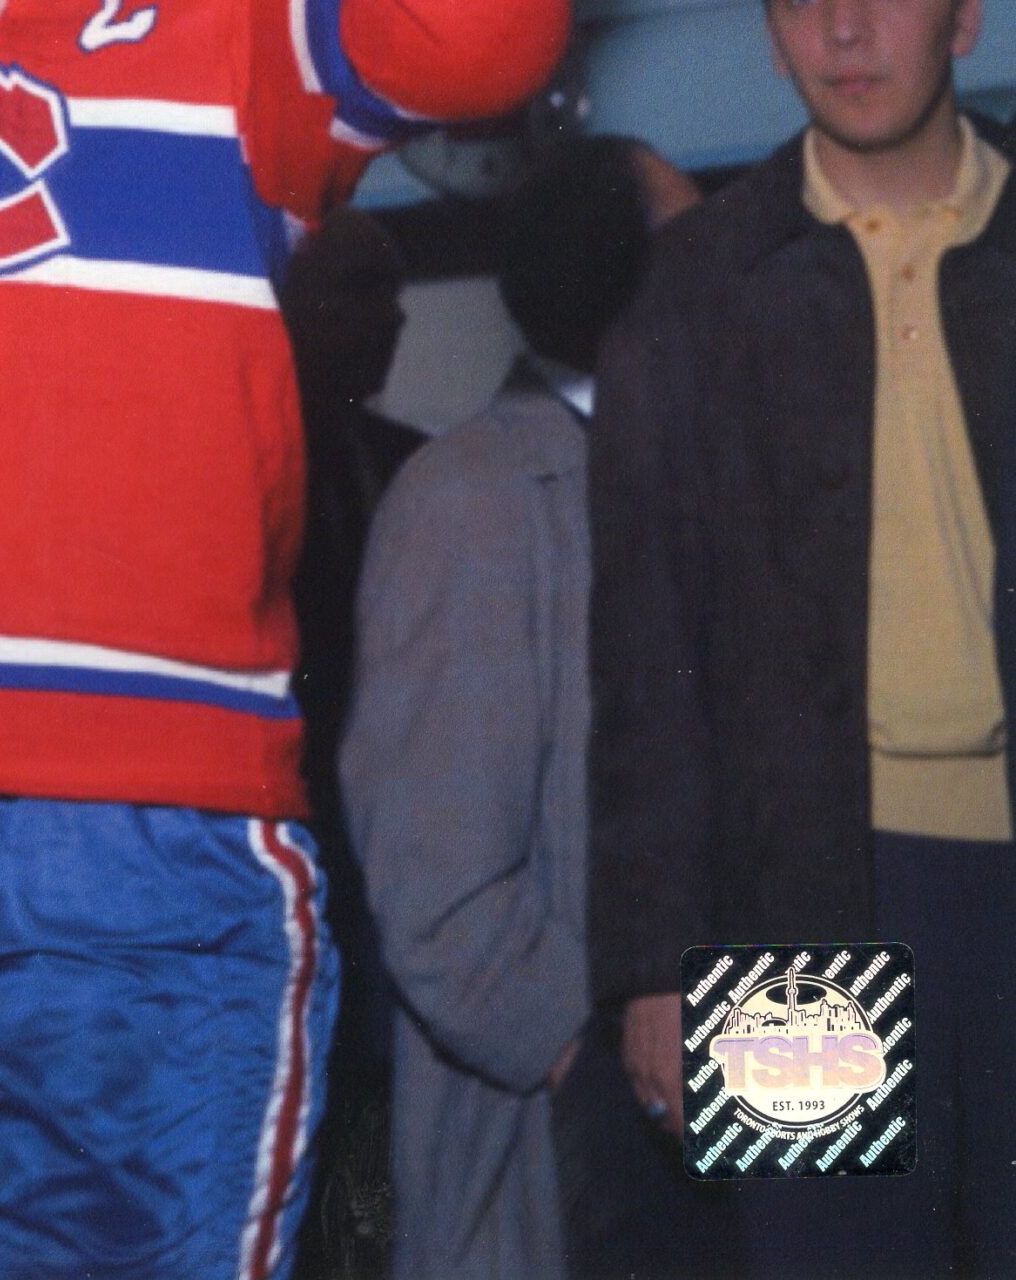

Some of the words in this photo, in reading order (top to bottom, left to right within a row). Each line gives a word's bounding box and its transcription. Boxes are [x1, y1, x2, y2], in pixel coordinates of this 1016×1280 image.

[687, 955, 733, 1007] Authentic
[728, 952, 775, 1003] Authentic
[822, 950, 851, 979] entic
[849, 951, 890, 997] uthentic
[684, 1001, 731, 1053] Authentic
[687, 1059, 720, 1093] Authe
[713, 1033, 881, 1090] TSHS
[866, 1059, 913, 1111] Authentic
[689, 1086, 731, 1135] Authent
[733, 1107, 767, 1133] TORONTO
[839, 1104, 865, 1128] SHOWS
[772, 1100, 794, 1112] EST.
[798, 1100, 825, 1111] 1993
[695, 1122, 743, 1173] Authentic
[816, 1121, 862, 1172] Authentic
[859, 1116, 906, 1168] Authentic
